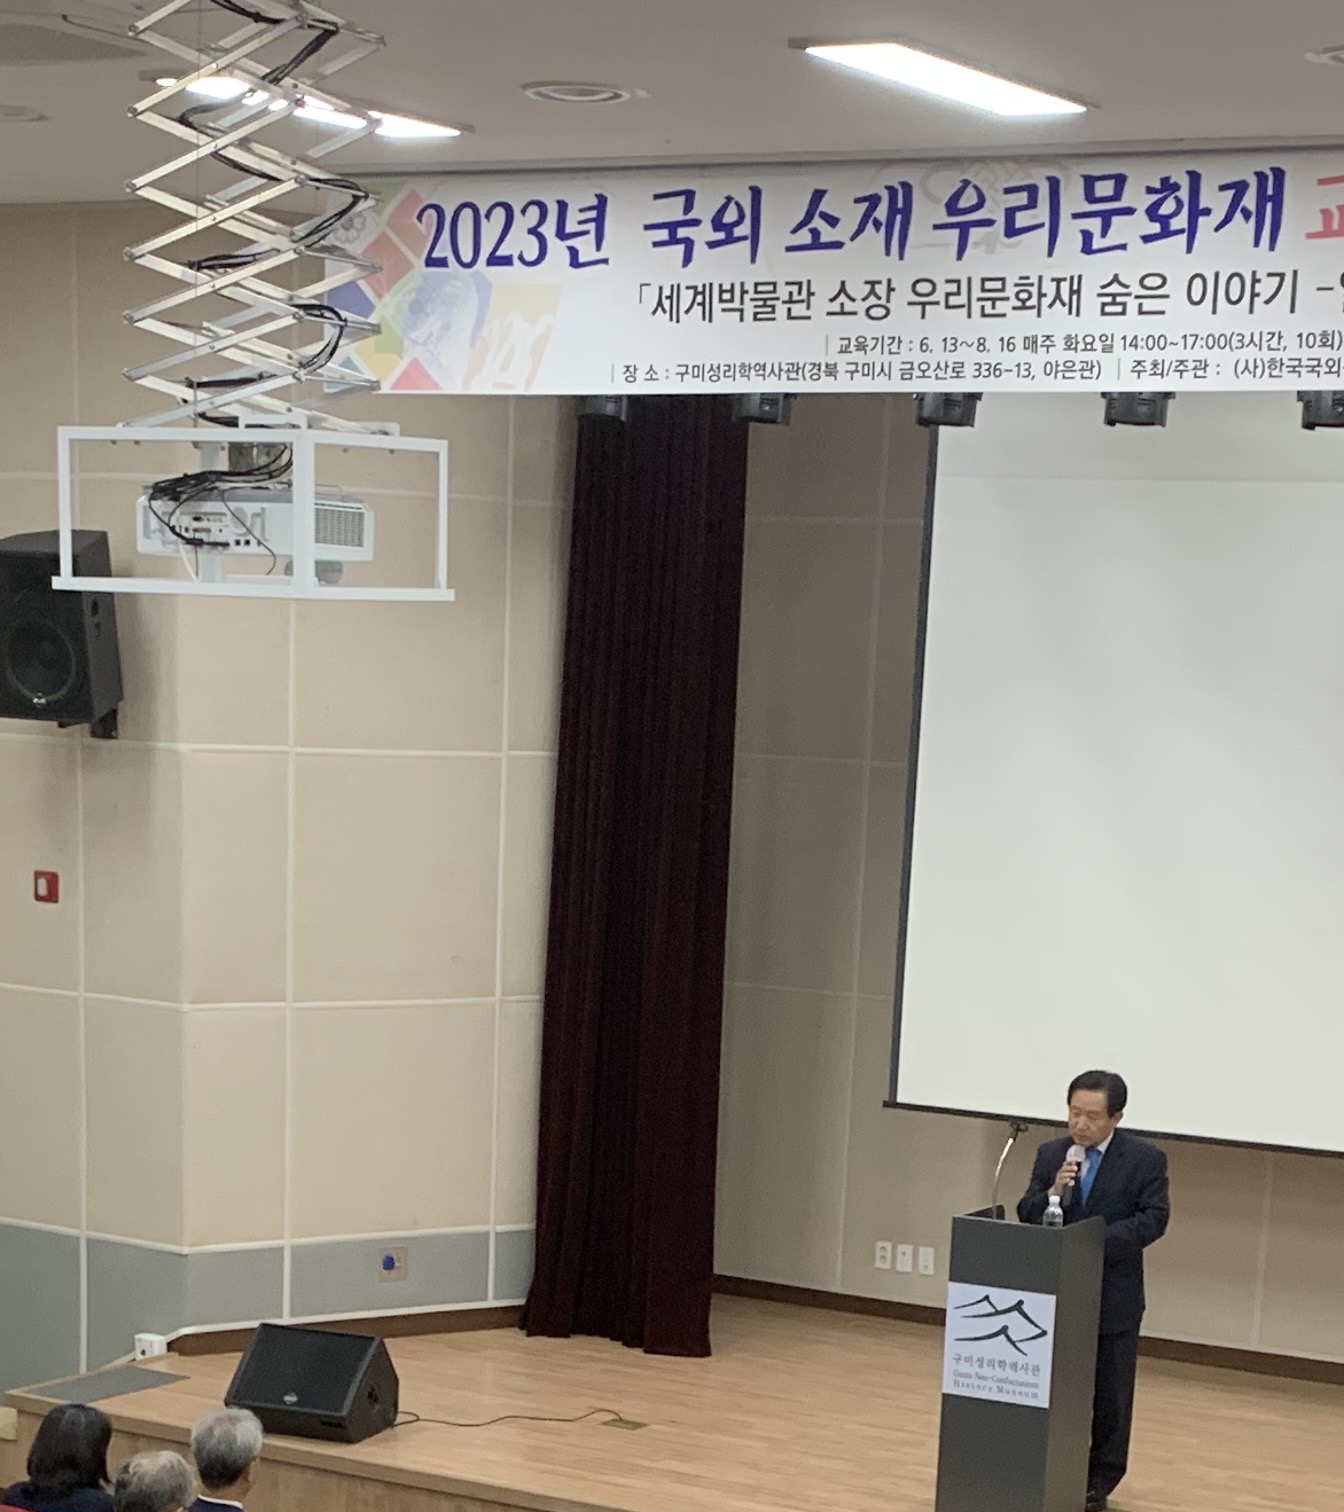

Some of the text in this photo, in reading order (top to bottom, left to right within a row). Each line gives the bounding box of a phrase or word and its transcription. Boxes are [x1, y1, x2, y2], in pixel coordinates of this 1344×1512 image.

[415, 192, 610, 270] 2023년
[642, 185, 763, 269] 국외
[784, 180, 914, 262] 소재
[931, 165, 1287, 262] 우리문화재
[824, 277, 897, 321] 소장
[906, 272, 1083, 321] 우리문화재
[1096, 270, 1172, 318] 숨은
[1185, 268, 1300, 315] 이야기
[836, 334, 904, 356] 교육기간
[919, 336, 934, 354] 6.
[998, 335, 1017, 353] 16
[1022, 334, 1057, 354] 매주
[1062, 332, 1115, 354] 화요일
[1120, 330, 1288, 353] 14:00~17:00(3시간,
[1295, 329, 1344, 352] 10회)
[622, 363, 639, 383] 장
[643, 364, 660, 381] 소
[674, 361, 840, 383] 구미성리학역사관(경북
[844, 361, 892, 382] 구미시
[898, 360, 967, 382] 금오산로
[971, 361, 1036, 381] 336-13,
[1043, 359, 1102, 381] 야은관)
[1129, 358, 1210, 380] 주최/주관
